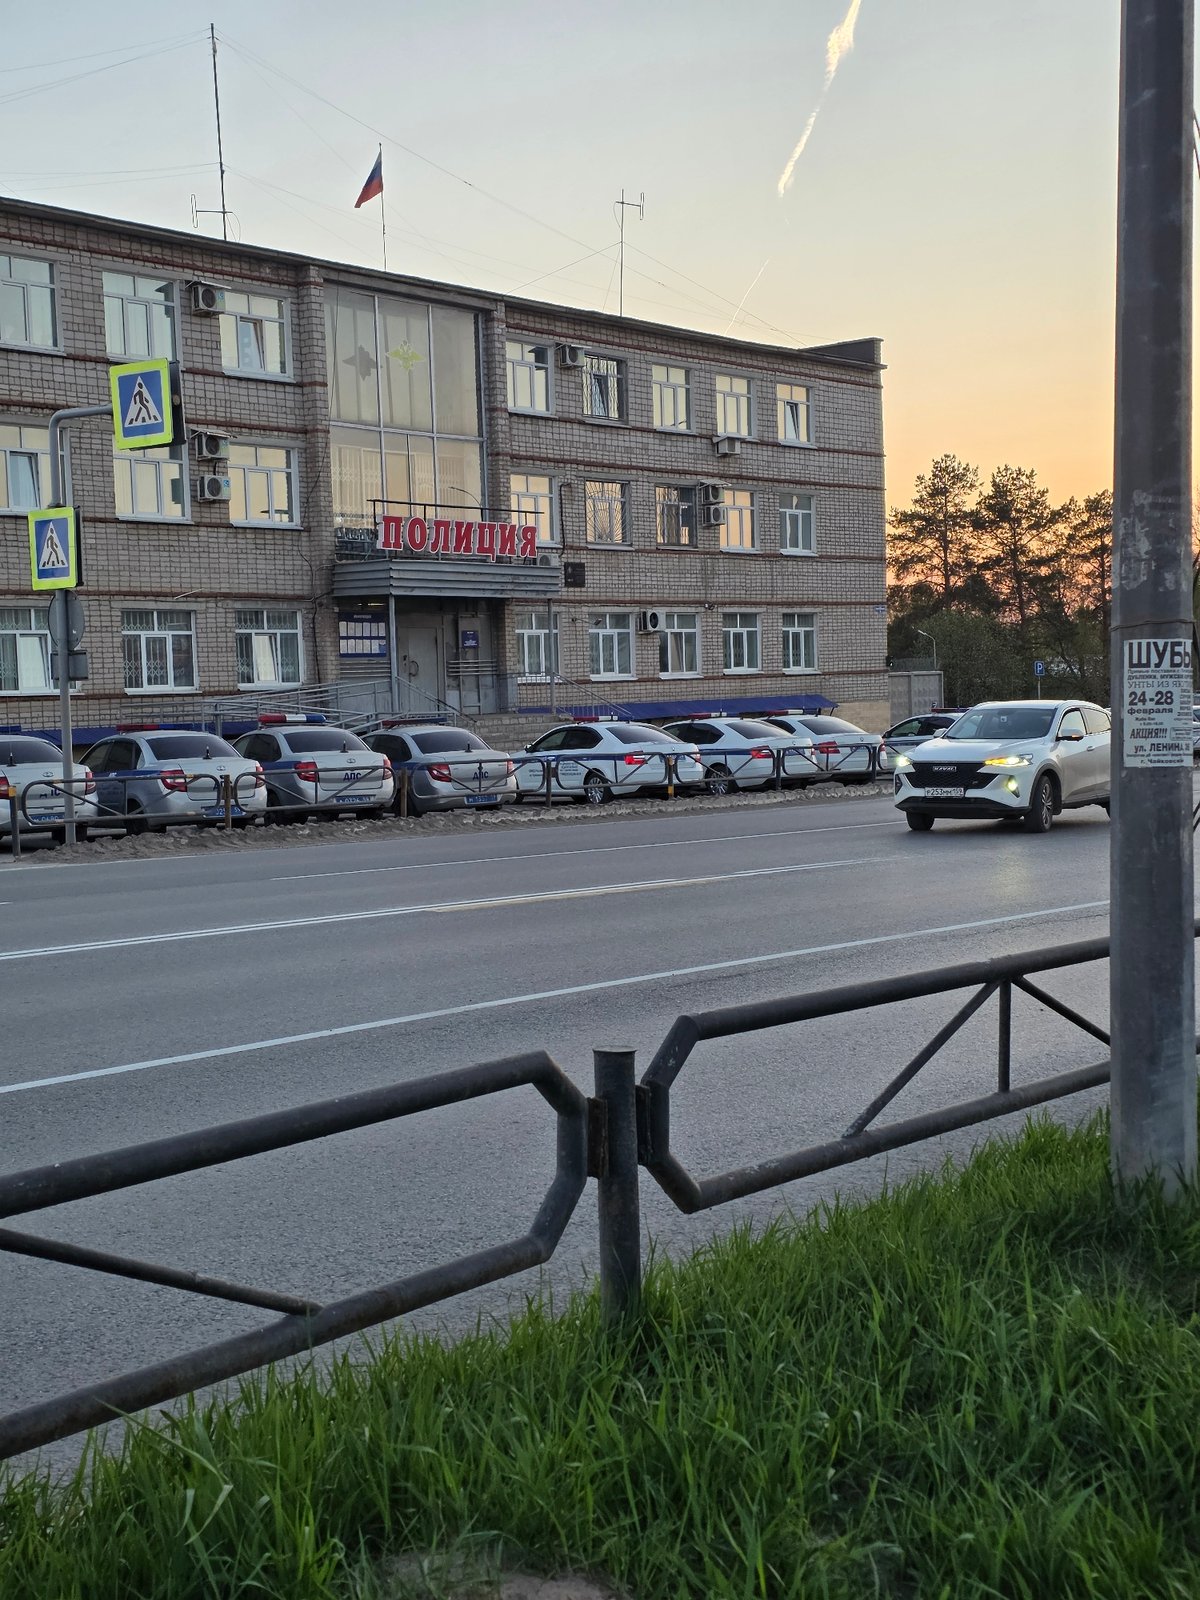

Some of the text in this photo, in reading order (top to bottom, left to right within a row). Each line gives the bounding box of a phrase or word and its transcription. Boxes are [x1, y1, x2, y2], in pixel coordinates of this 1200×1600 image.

[381, 515, 538, 563] ПОЛИЦИЯ
[1127, 707, 1173, 715] февраля
[1130, 728, 1168, 740] АКЦИЯ!!!
[1134, 745, 1147, 753] ул.
